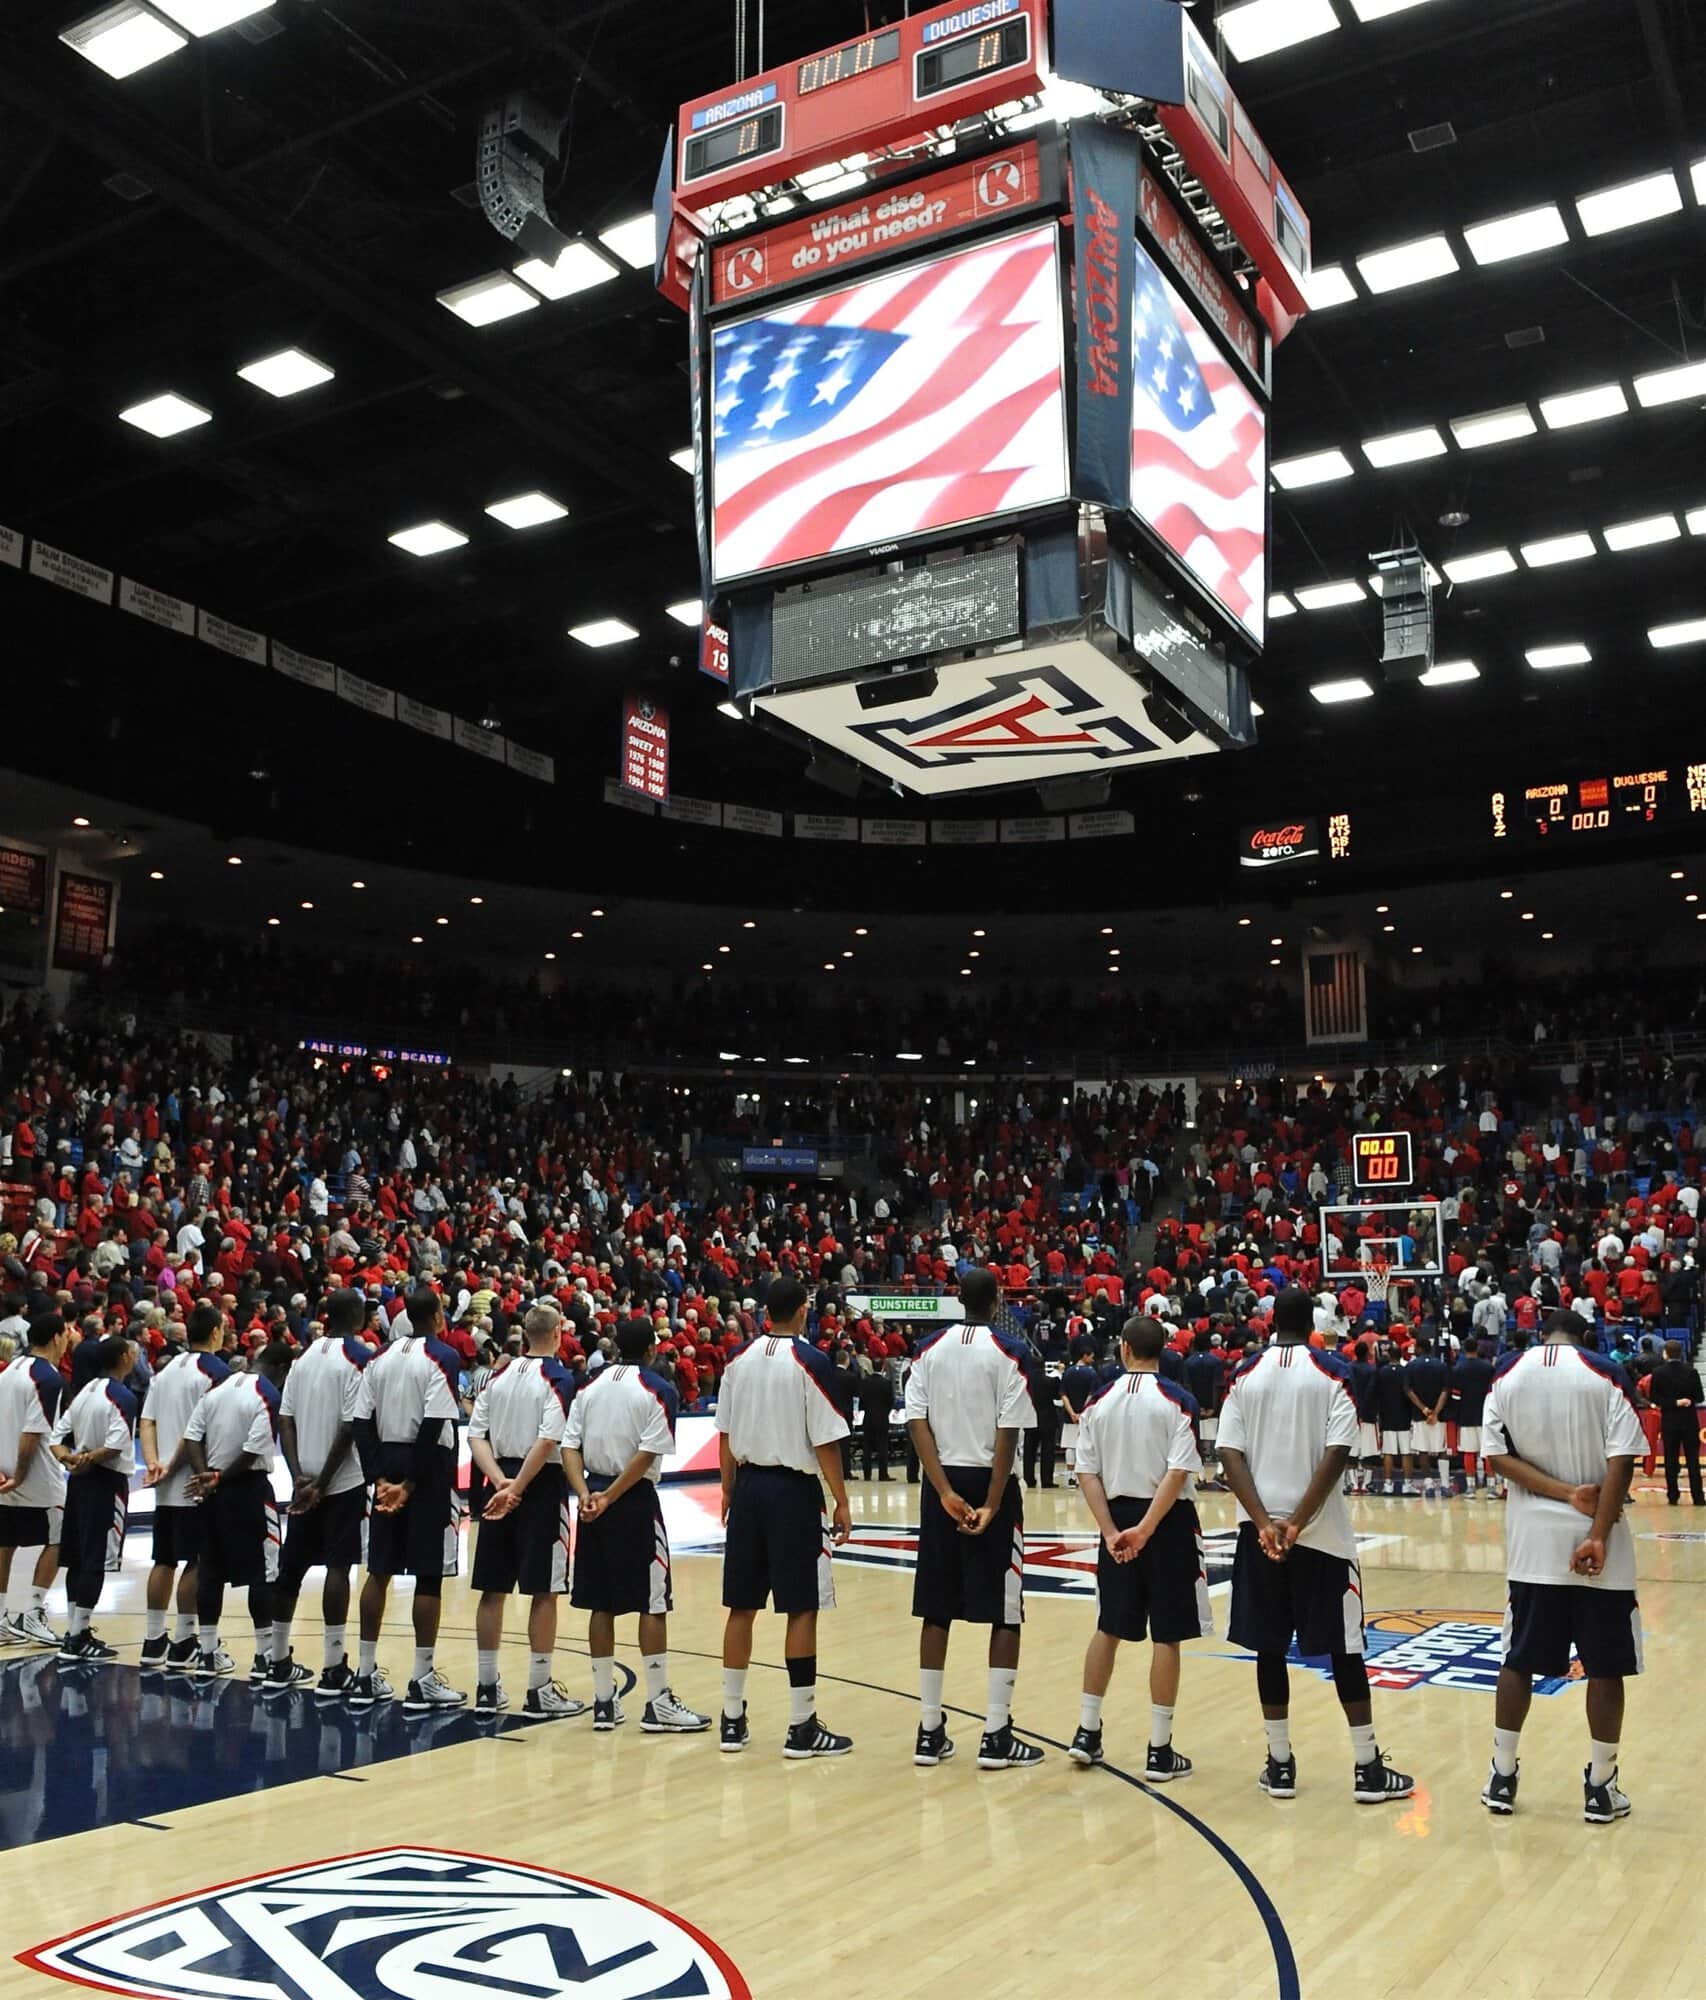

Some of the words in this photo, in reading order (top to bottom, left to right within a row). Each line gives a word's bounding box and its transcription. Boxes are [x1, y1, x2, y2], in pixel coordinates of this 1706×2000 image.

[930, 0, 1012, 40] DUQUESNE
[978, 32, 1000, 70] 0
[705, 89, 763, 125] ARIZONA
[737, 119, 759, 155] 0
[811, 206, 869, 242] What
[876, 192, 925, 221] else
[791, 245, 821, 270] do
[826, 233, 868, 261] you
[873, 200, 947, 243] need?
[1086, 187, 1119, 396] ARIZONA
[712, 649, 729, 671] 19
[628, 715, 666, 740] ARIZONA
[628, 735, 653, 753] SWEET
[656, 747, 665, 758] 16
[648, 769, 664, 783] 1991
[1613, 769, 1669, 788] DUQUESNE
[1525, 784, 1568, 799] ARIZONA
[1644, 786, 1656, 803] 0
[1549, 798, 1561, 815] 0
[1329, 825, 1351, 838] PTS
[1572, 810, 1609, 831] 00.0
[1360, 1139, 1395, 1155] 00.0
[1368, 1157, 1398, 1180] 00
[872, 1300, 935, 1310] SUNSTREET
[1364, 1622, 1503, 1672] SPORTS
